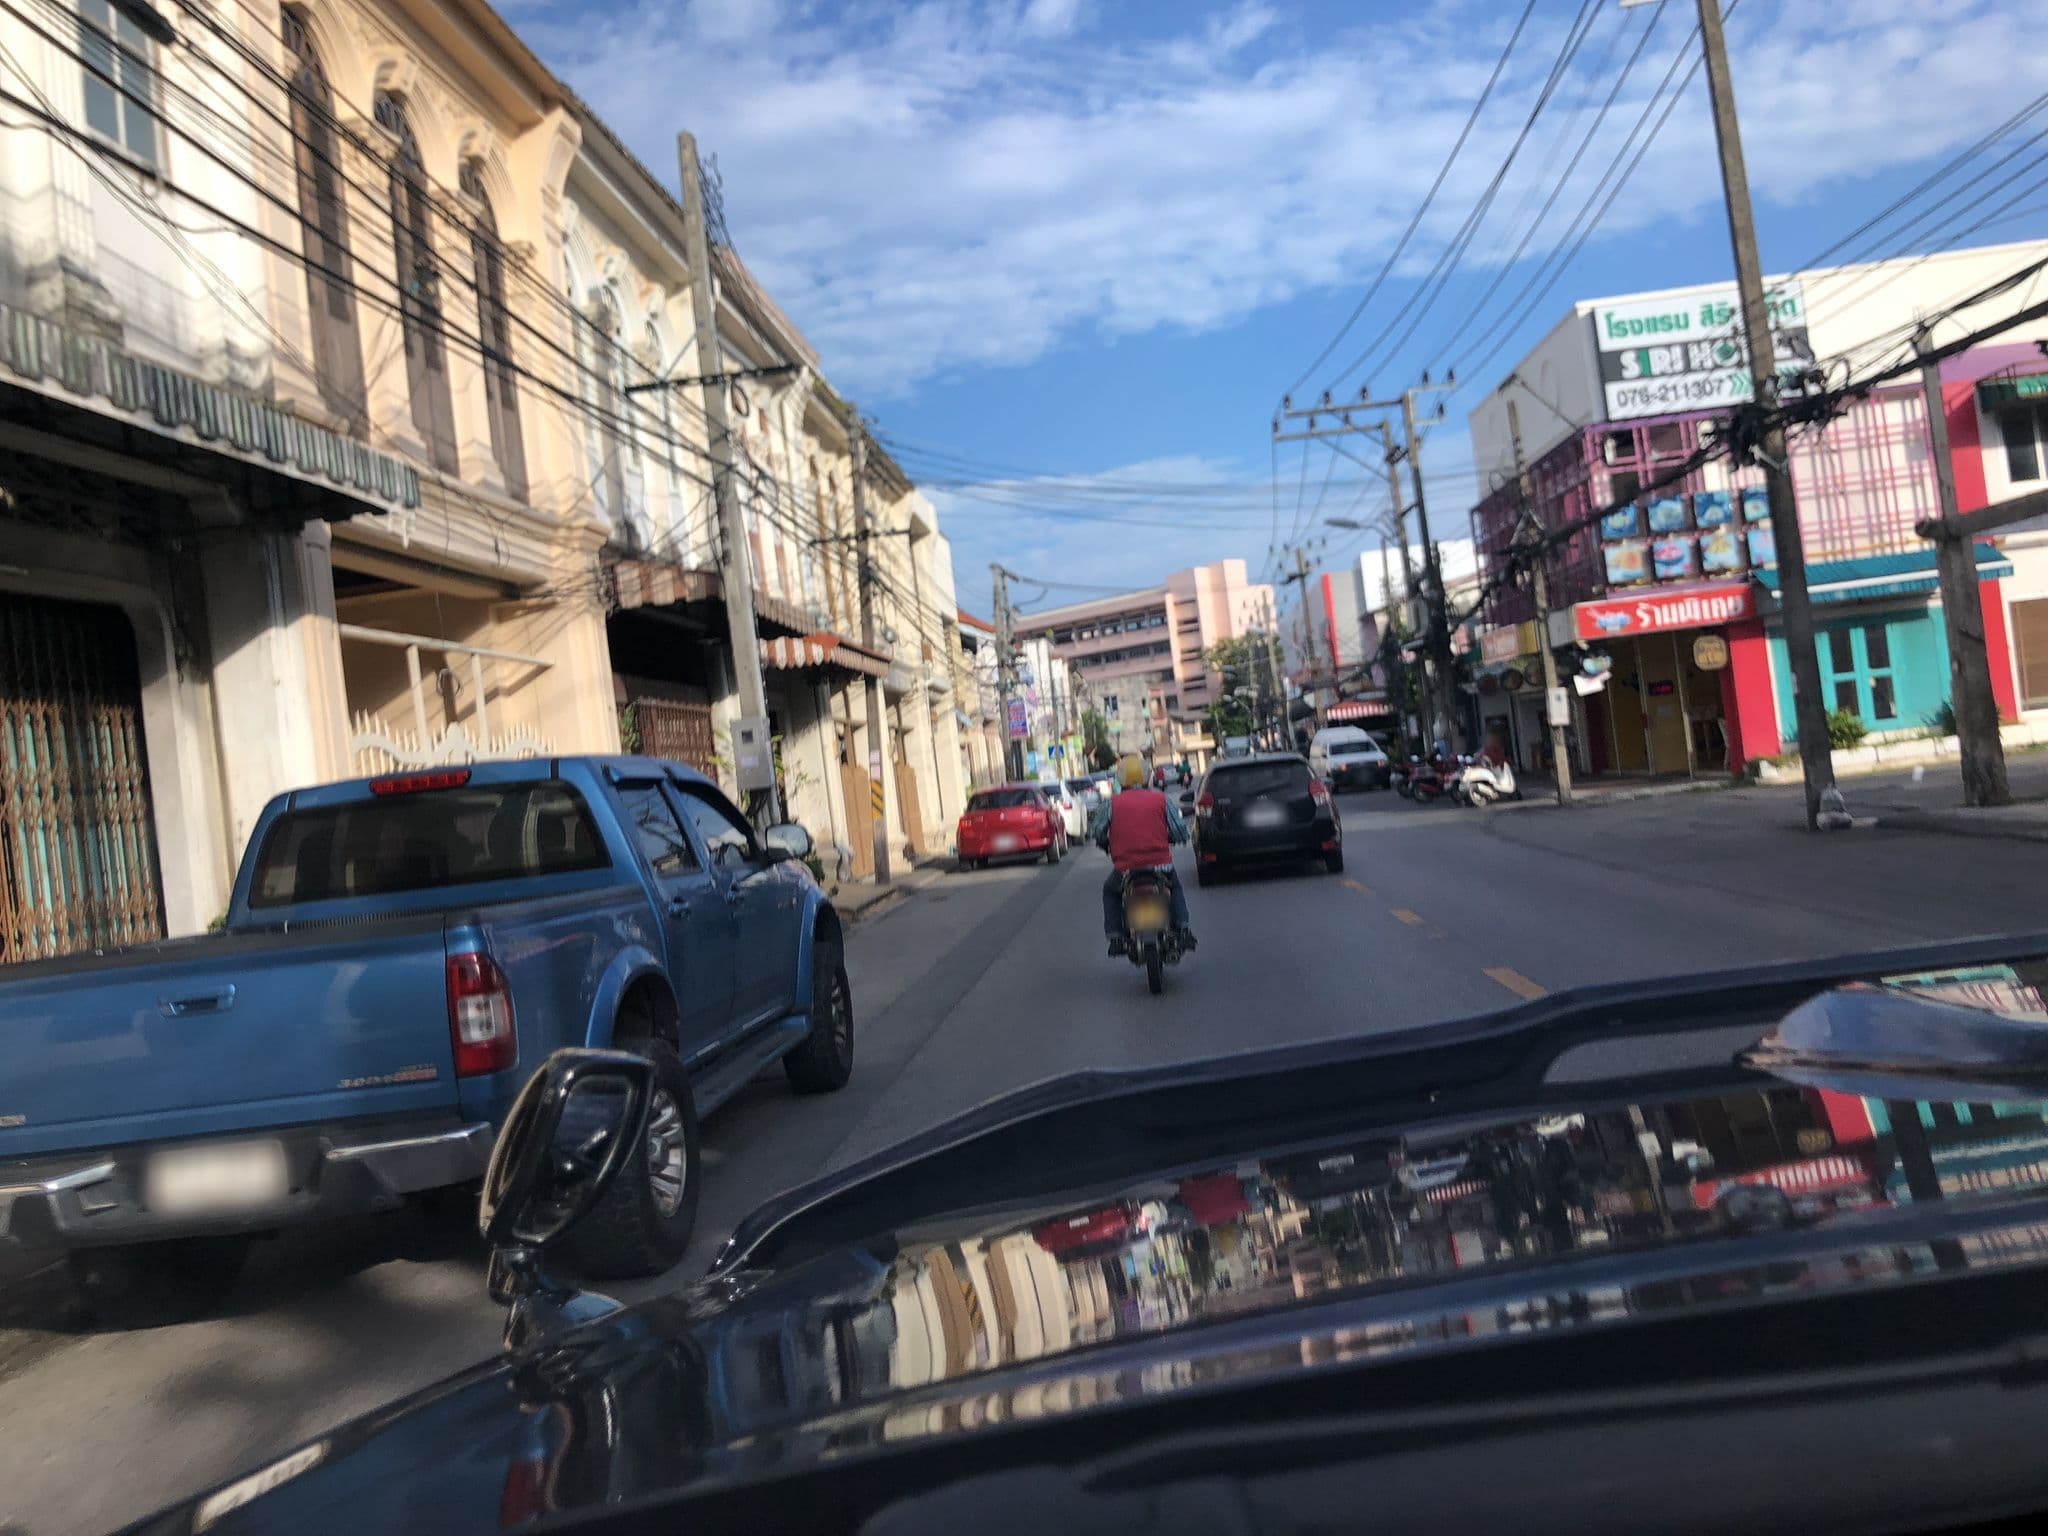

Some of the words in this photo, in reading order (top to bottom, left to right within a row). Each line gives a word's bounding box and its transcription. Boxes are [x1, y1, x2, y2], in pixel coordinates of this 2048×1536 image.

[1604, 311, 1690, 339] โรงแรม
[1620, 344, 1685, 379] SIRI
[1616, 378, 1726, 408] 076-211307
